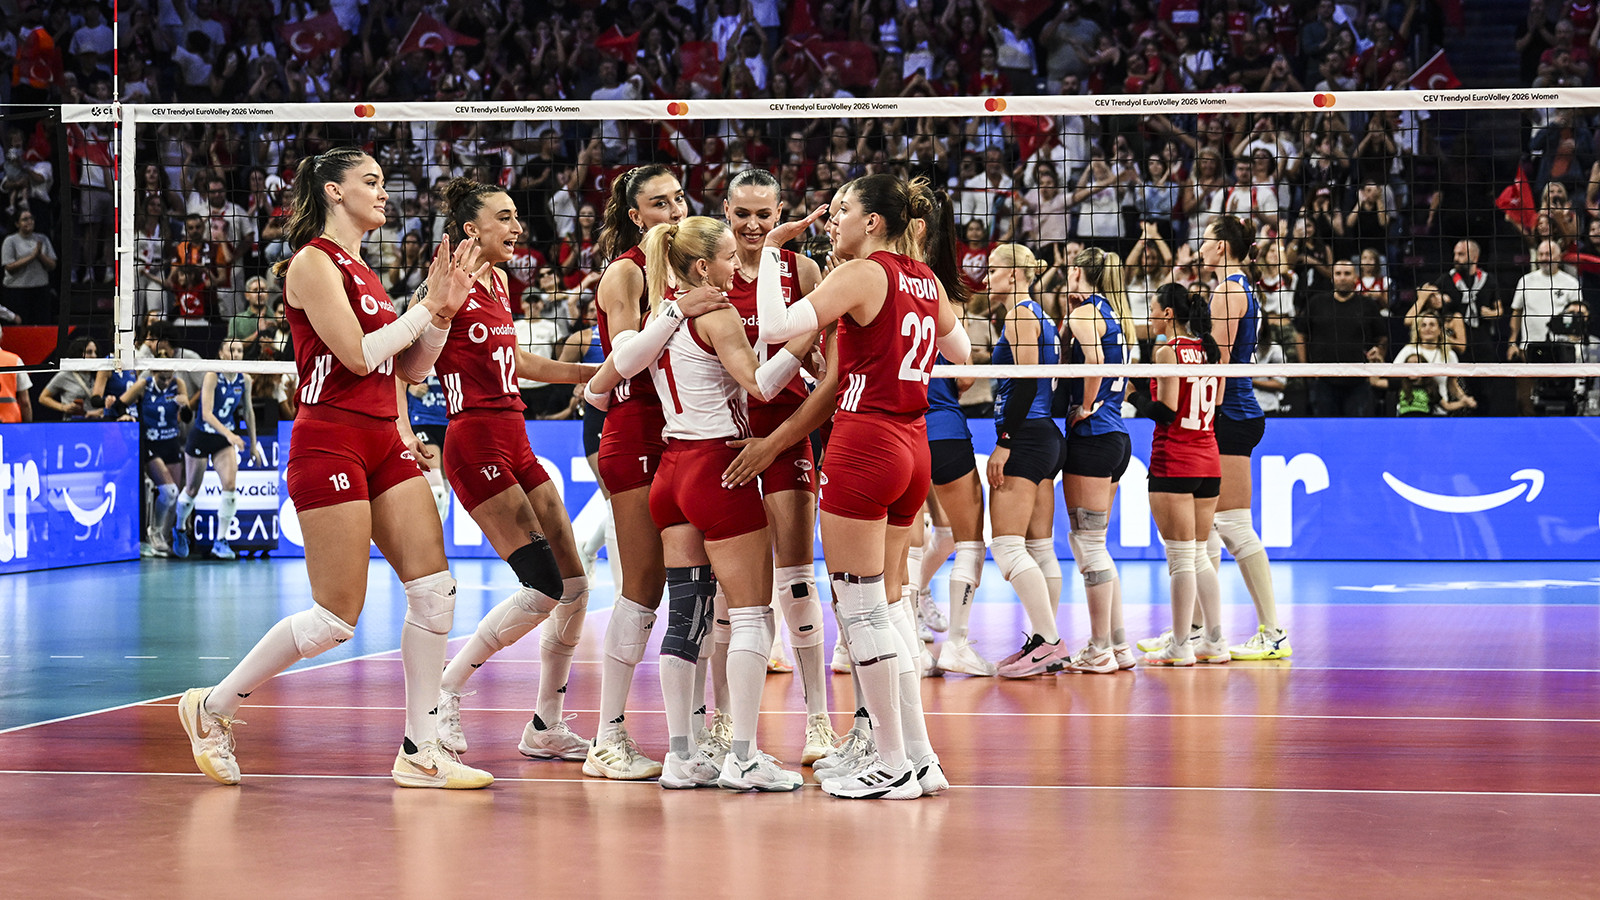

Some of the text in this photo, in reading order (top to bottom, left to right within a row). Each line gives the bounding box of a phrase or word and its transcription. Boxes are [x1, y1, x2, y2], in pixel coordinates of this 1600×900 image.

[769, 102, 898, 112] CEV Trendyol EuroVolley 2026 Women
[1094, 99, 1110, 107] CEV
[1110, 98, 1142, 108] Trendyol
[1142, 98, 1180, 107] EuroVolley
[1180, 97, 1199, 106] 2026
[1422, 94, 1439, 103] CEV
[1439, 93, 1471, 103] Trendyol
[1472, 93, 1511, 103] EuroVolley
[1511, 92, 1530, 101] 2026
[151, 108, 166, 116] CEV
[166, 108, 195, 117] Trendyol
[195, 107, 231, 117] EuroVolley
[231, 107, 248, 116] 2026
[454, 105, 580, 115] CEV Trendyol EuroVolley 2026 Women
[898, 271, 938, 300] AYDIN
[897, 311, 936, 386] 22
[491, 345, 520, 394] 12
[657, 347, 684, 415] 1
[218, 397, 235, 418] 5
[1180, 376, 1219, 431] 19
[157, 405, 167, 427] 1
[480, 464, 501, 481] 12
[638, 456, 649, 473] 7
[328, 471, 351, 492] 18
